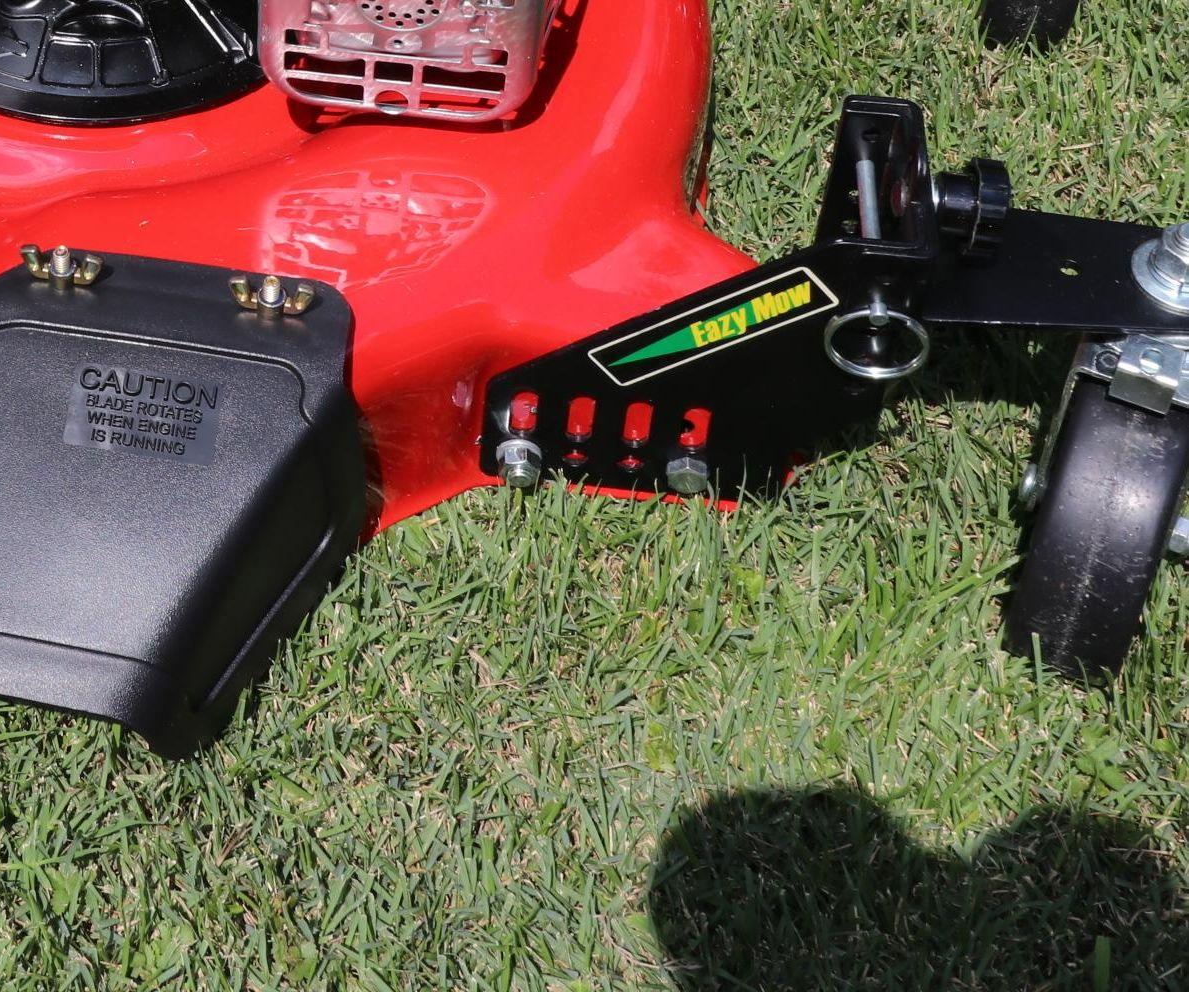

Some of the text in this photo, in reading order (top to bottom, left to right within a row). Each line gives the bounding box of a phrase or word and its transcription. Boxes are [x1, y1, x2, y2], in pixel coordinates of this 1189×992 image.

[689, 280, 811, 348] Eazy Mow
[79, 367, 219, 409] CAUTION
[85, 393, 203, 424] BLADE ROTATES
[86, 410, 197, 441] WHEN ENGINE
[90, 428, 186, 456] IS RUNNING
